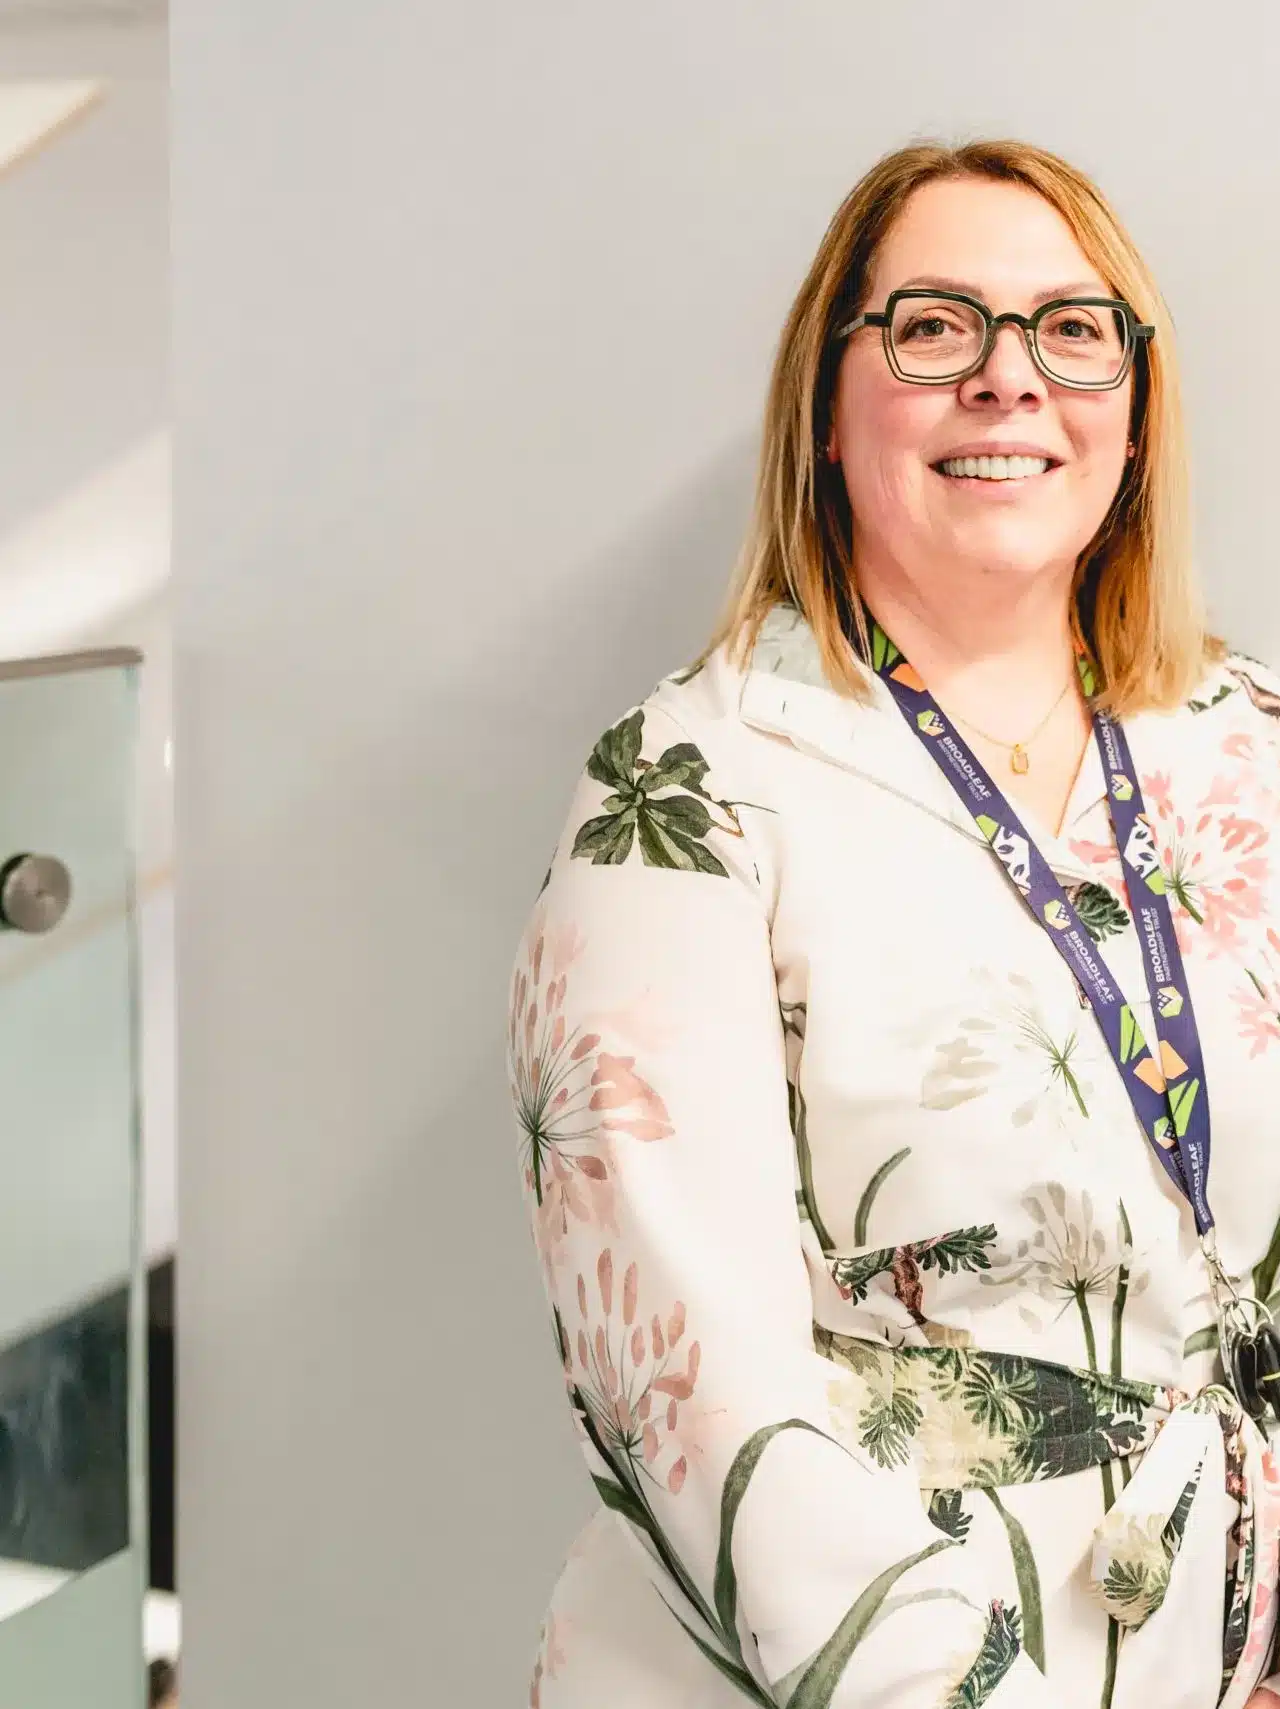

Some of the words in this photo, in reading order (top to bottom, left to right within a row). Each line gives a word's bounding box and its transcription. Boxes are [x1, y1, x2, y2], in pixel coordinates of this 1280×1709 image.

[942, 736, 992, 799] BROADLEAF
[1069, 930, 1115, 1003] BROADLEAF
[1141, 908, 1165, 983] BROADLEAF
